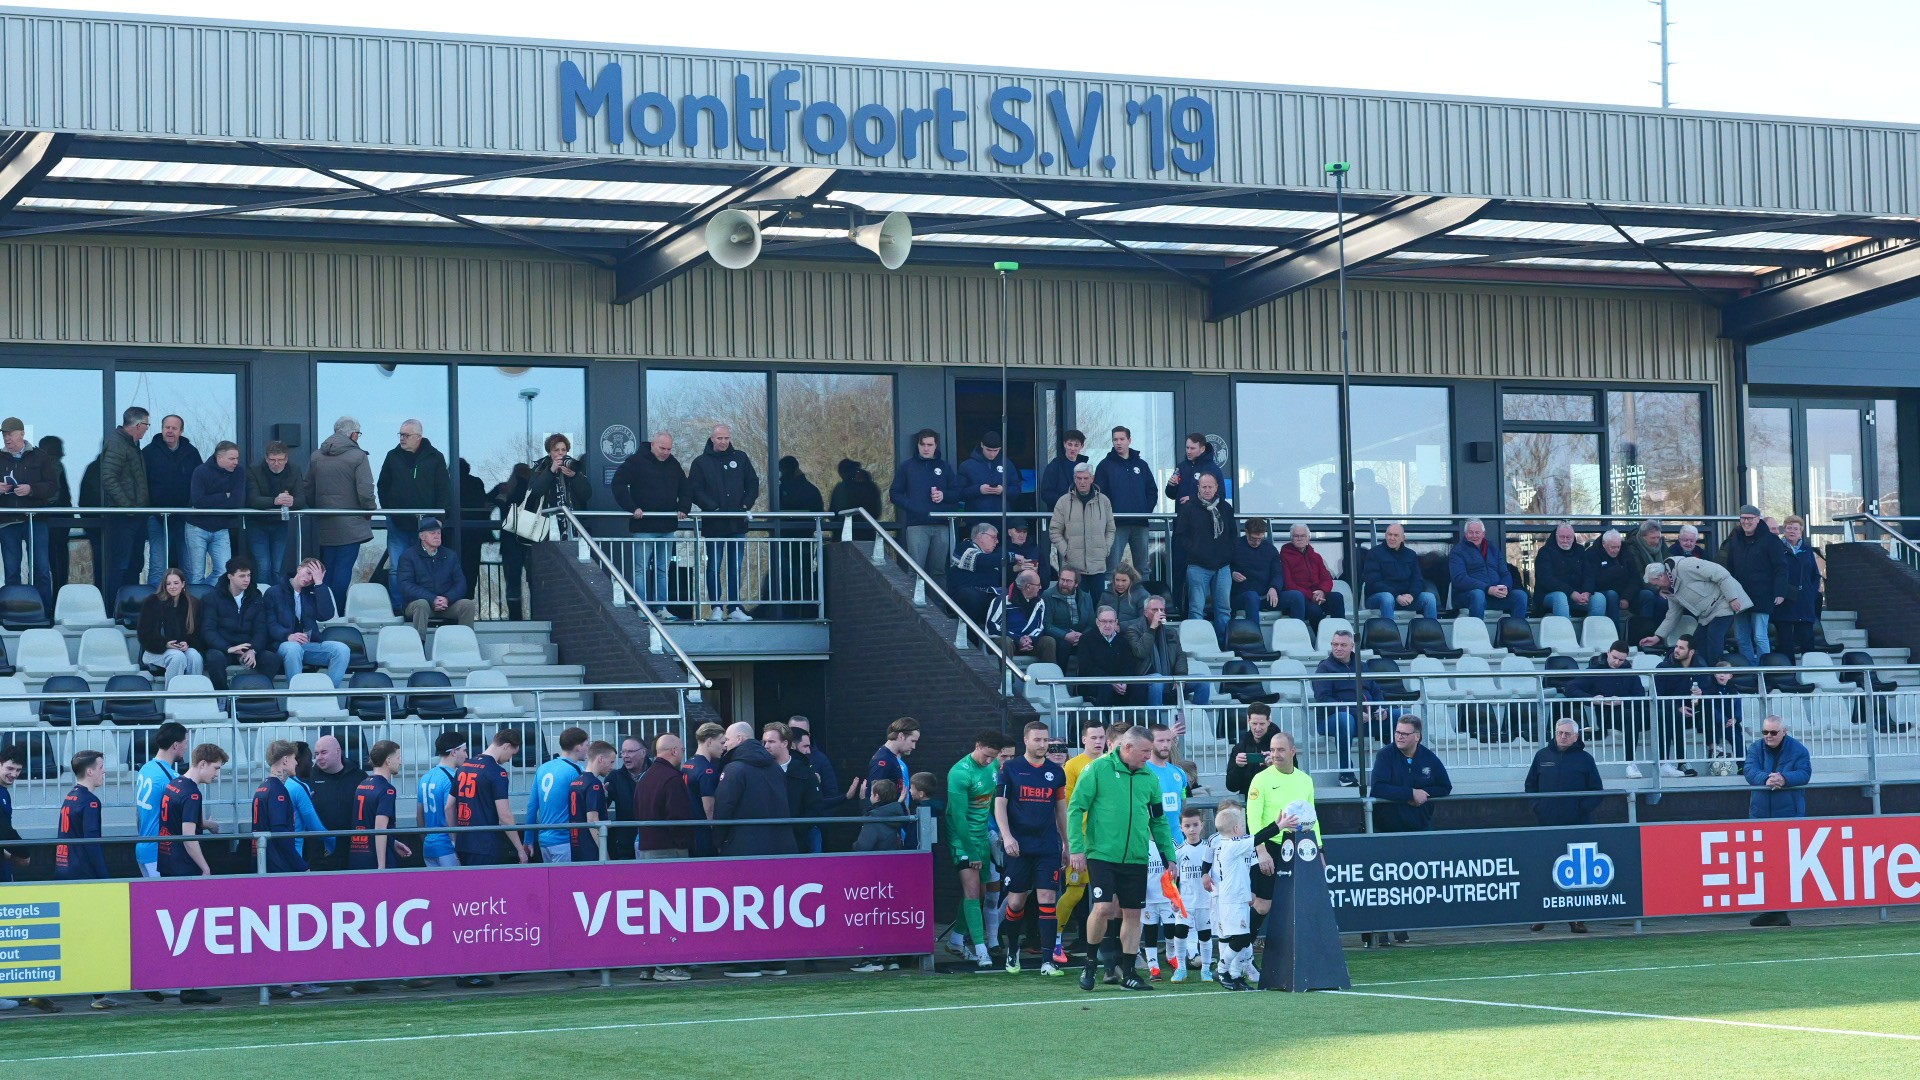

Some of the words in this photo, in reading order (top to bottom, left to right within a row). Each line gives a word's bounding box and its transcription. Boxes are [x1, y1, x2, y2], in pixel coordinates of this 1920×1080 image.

[559, 59, 967, 164] Montfoort
[989, 85, 1117, 170] S.V.
[136, 773, 153, 811] 22
[421, 782, 437, 813] 15
[457, 771, 478, 799] 25
[541, 772, 554, 802] 9
[161, 794, 170, 822] 5
[357, 795, 365, 821] 7
[570, 791, 577, 816] 8
[60, 806, 70, 833] 16
[1324, 863, 1364, 883] CHE
[1369, 858, 1520, 882] GROOTHANDEL
[1555, 845, 1612, 888] db
[1788, 826, 1920, 902] Kire
[843, 880, 895, 901] werkt
[1543, 894, 1626, 908] DEBRUINBV.NL
[452, 896, 507, 917] werkt
[572, 882, 826, 937] VENDRIG
[844, 905, 926, 930] verfrissig
[0, 926, 29, 940] ating
[155, 898, 433, 957] VENDRIG
[452, 921, 541, 947] verfrissig
[0, 949, 20, 960] out
[0, 967, 56, 981] erlichting
